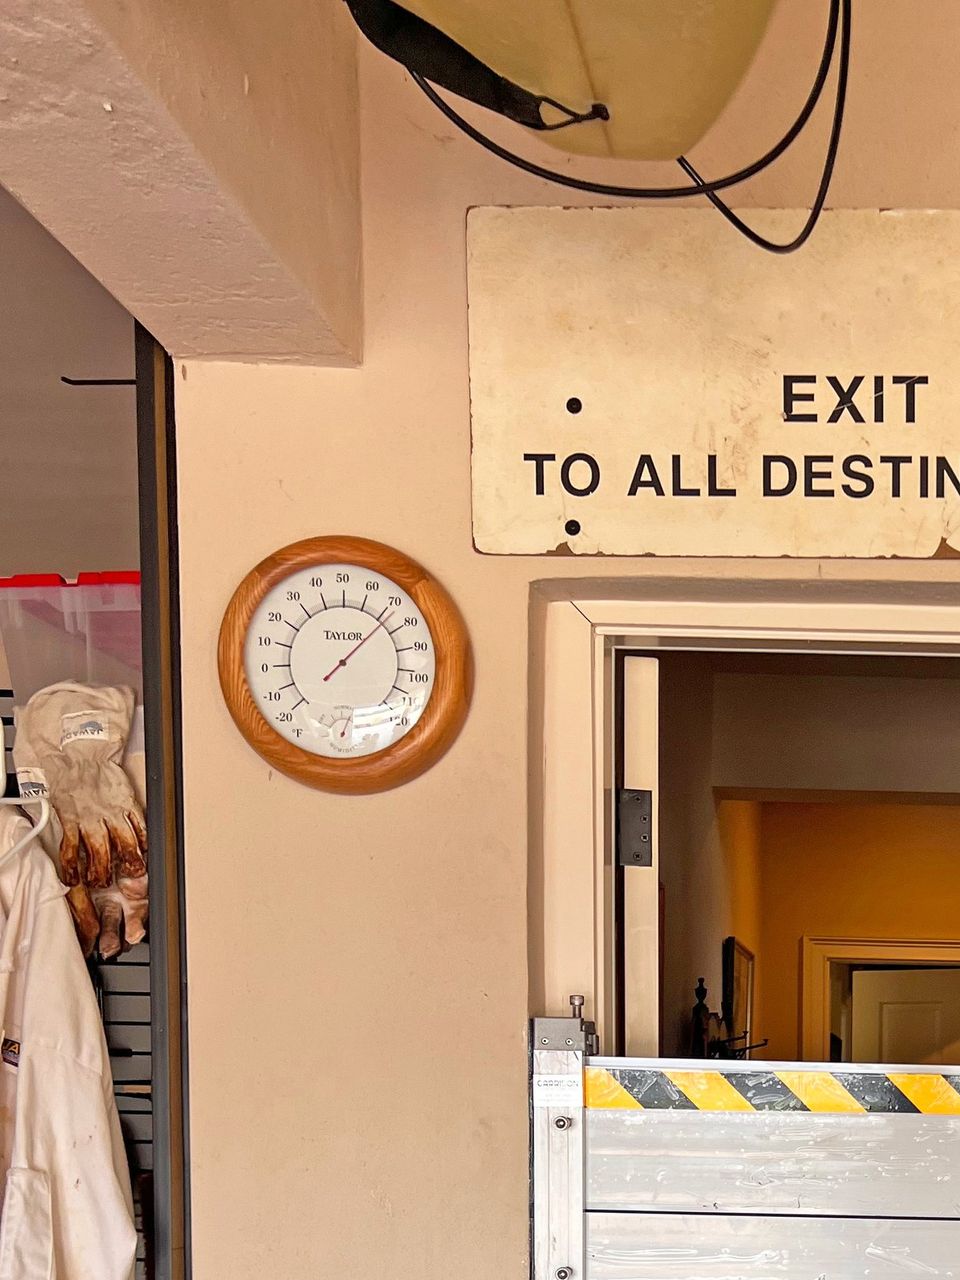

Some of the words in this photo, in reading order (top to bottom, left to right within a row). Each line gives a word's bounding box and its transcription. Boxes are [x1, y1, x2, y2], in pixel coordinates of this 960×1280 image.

[783, 375, 929, 423] EXIT
[523, 453, 600, 497] TO
[627, 454, 737, 497] ALL
[309, 577, 323, 587] 40
[336, 573, 350, 583] 50
[365, 581, 379, 591] 60
[286, 591, 300, 601] 30
[388, 596, 402, 606] 70
[268, 612, 282, 622] 20
[404, 617, 418, 627] 80
[323, 630, 362, 641] TAYLOR
[258, 636, 271, 647] 10
[414, 642, 428, 652] 90
[261, 663, 269, 673] 0
[409, 673, 429, 684] 100
[263, 691, 281, 701] -10
[275, 712, 293, 722] -20
